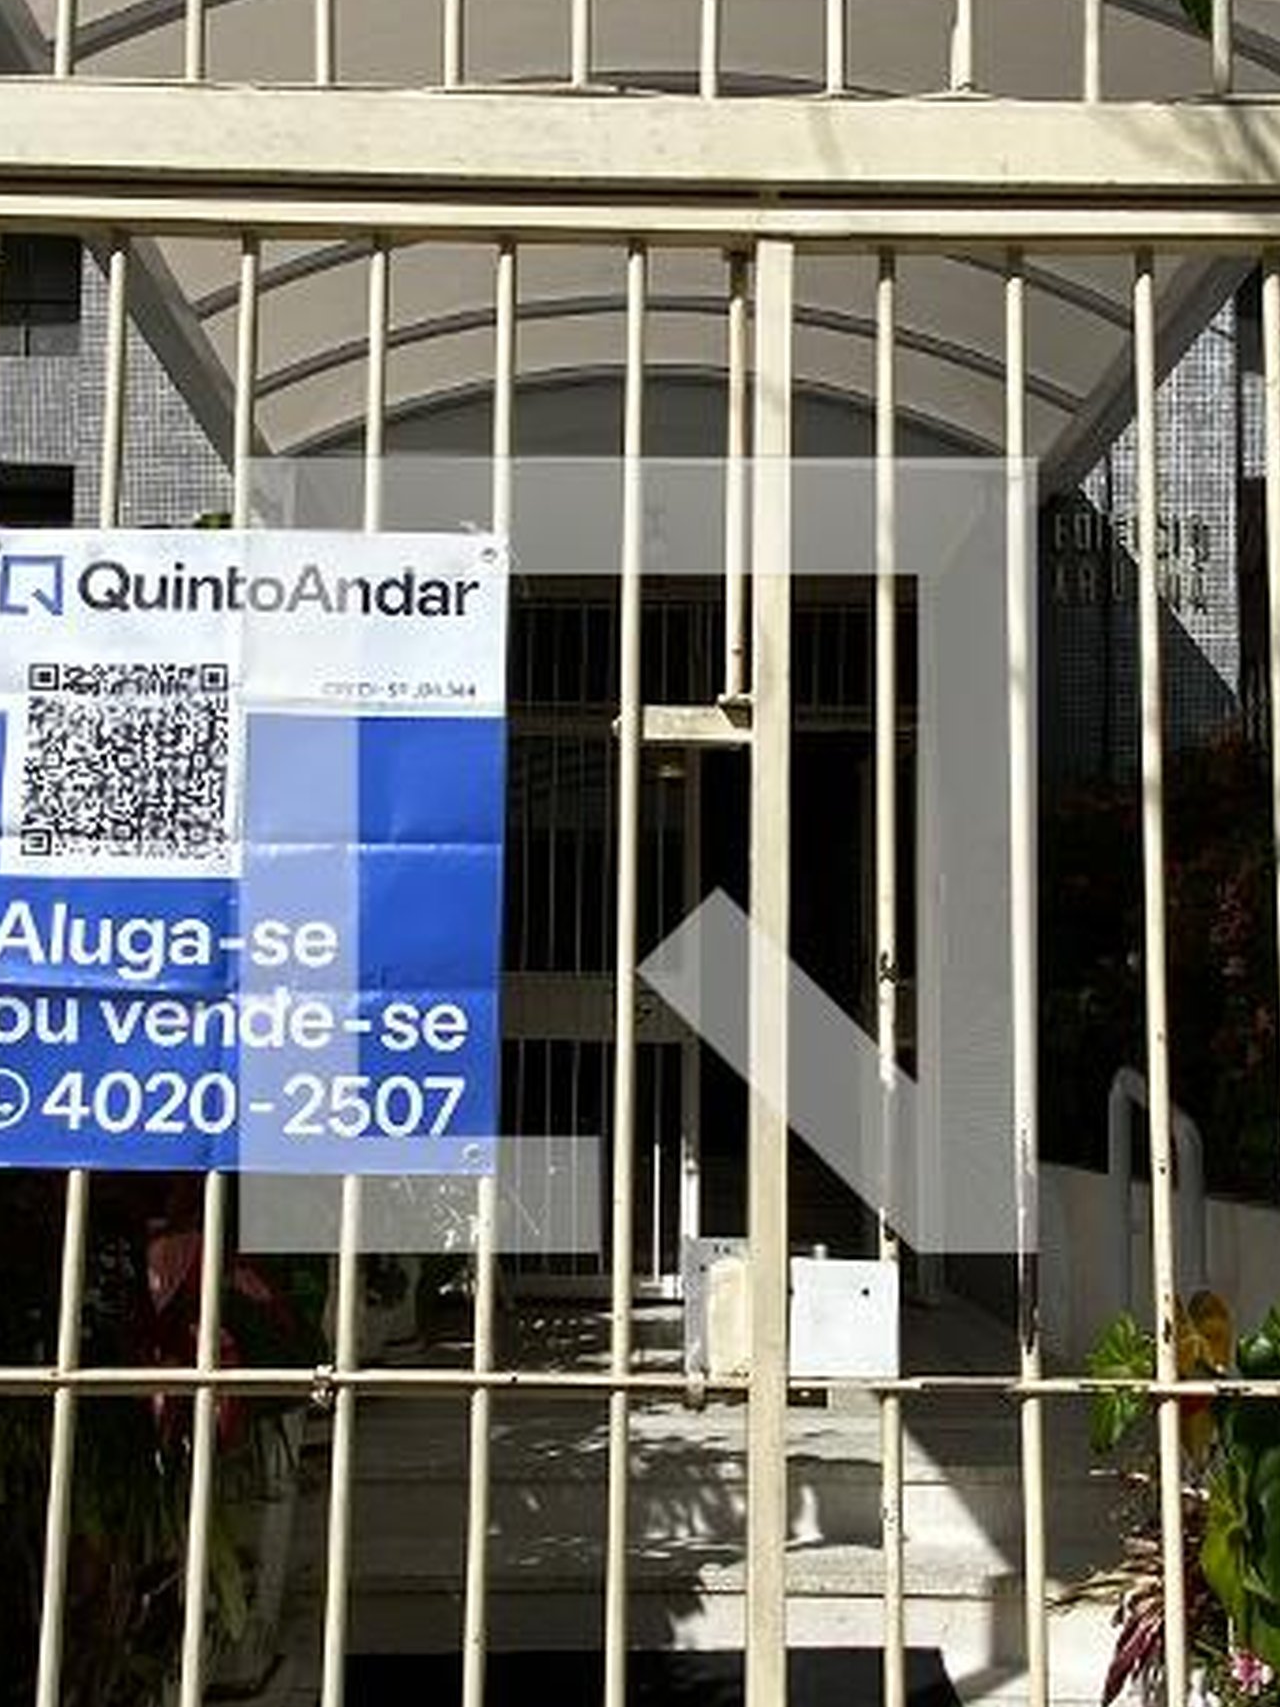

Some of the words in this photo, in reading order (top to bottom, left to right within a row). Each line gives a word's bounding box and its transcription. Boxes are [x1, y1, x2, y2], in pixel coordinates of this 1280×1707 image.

[77, 560, 481, 617] QuintoAndar
[100, 986, 469, 1052] vende-se
[41, 1071, 468, 1138] 4020-2507
